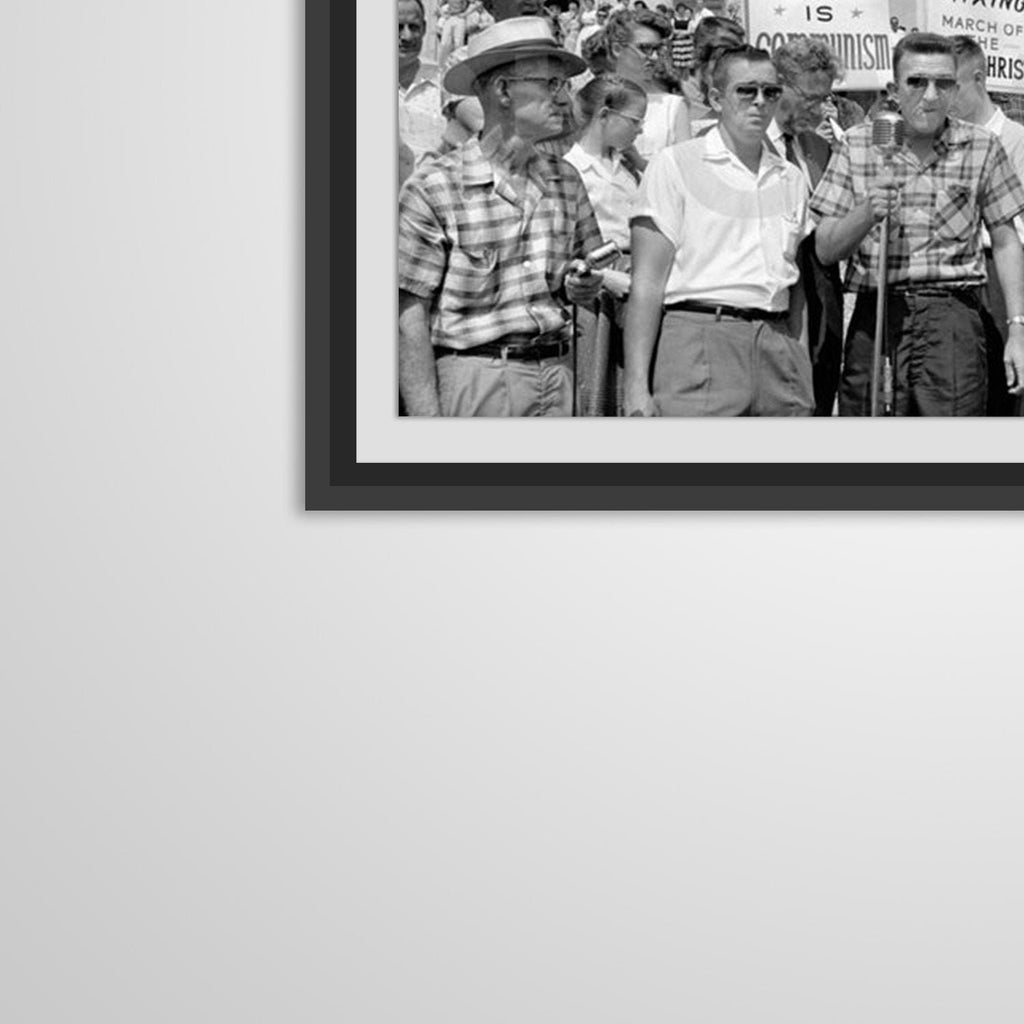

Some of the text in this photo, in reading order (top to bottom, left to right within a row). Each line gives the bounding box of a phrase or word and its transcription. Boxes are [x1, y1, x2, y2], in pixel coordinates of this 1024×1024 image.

[805, 5, 834, 22] IS
[941, 14, 1024, 36] MARCH OF
[969, 35, 999, 51] HE
